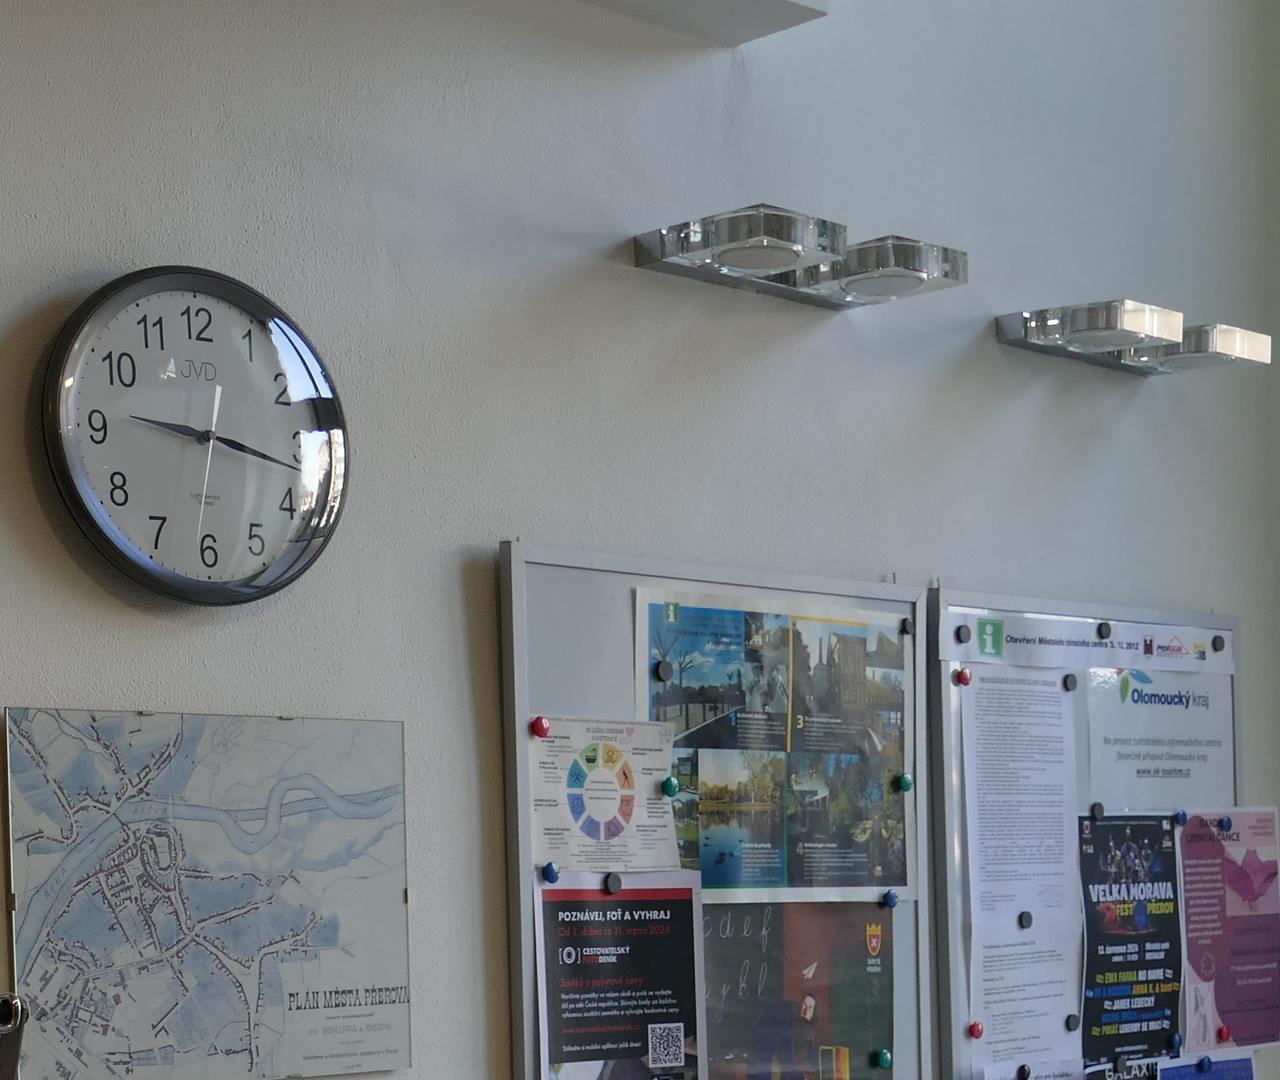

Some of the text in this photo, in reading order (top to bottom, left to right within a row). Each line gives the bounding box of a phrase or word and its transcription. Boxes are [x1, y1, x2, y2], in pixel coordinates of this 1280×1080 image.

[137, 314, 165, 350] 11
[180, 305, 213, 343] 12
[241, 328, 253, 363] 1
[102, 351, 136, 388] 10
[180, 359, 217, 381] JVD
[273, 372, 292, 406] 2
[87, 409, 108, 445] 9
[109, 471, 128, 506] 8
[279, 487, 297, 520] 4
[148, 516, 167, 550] 7
[248, 523, 265, 556] 5
[200, 534, 218, 568] 6
[1132, 688, 1209, 709] Olomoucký kraj
[1089, 880, 1174, 902] VELKÁ MORAVA
[558, 909, 671, 922] POZNÁVEJ, FOŤ A VYHRAJ
[1116, 903, 1134, 916] FEST
[720, 912, 734, 938] d
[760, 905, 774, 953] f
[323, 987, 361, 1008] MĚSTA
